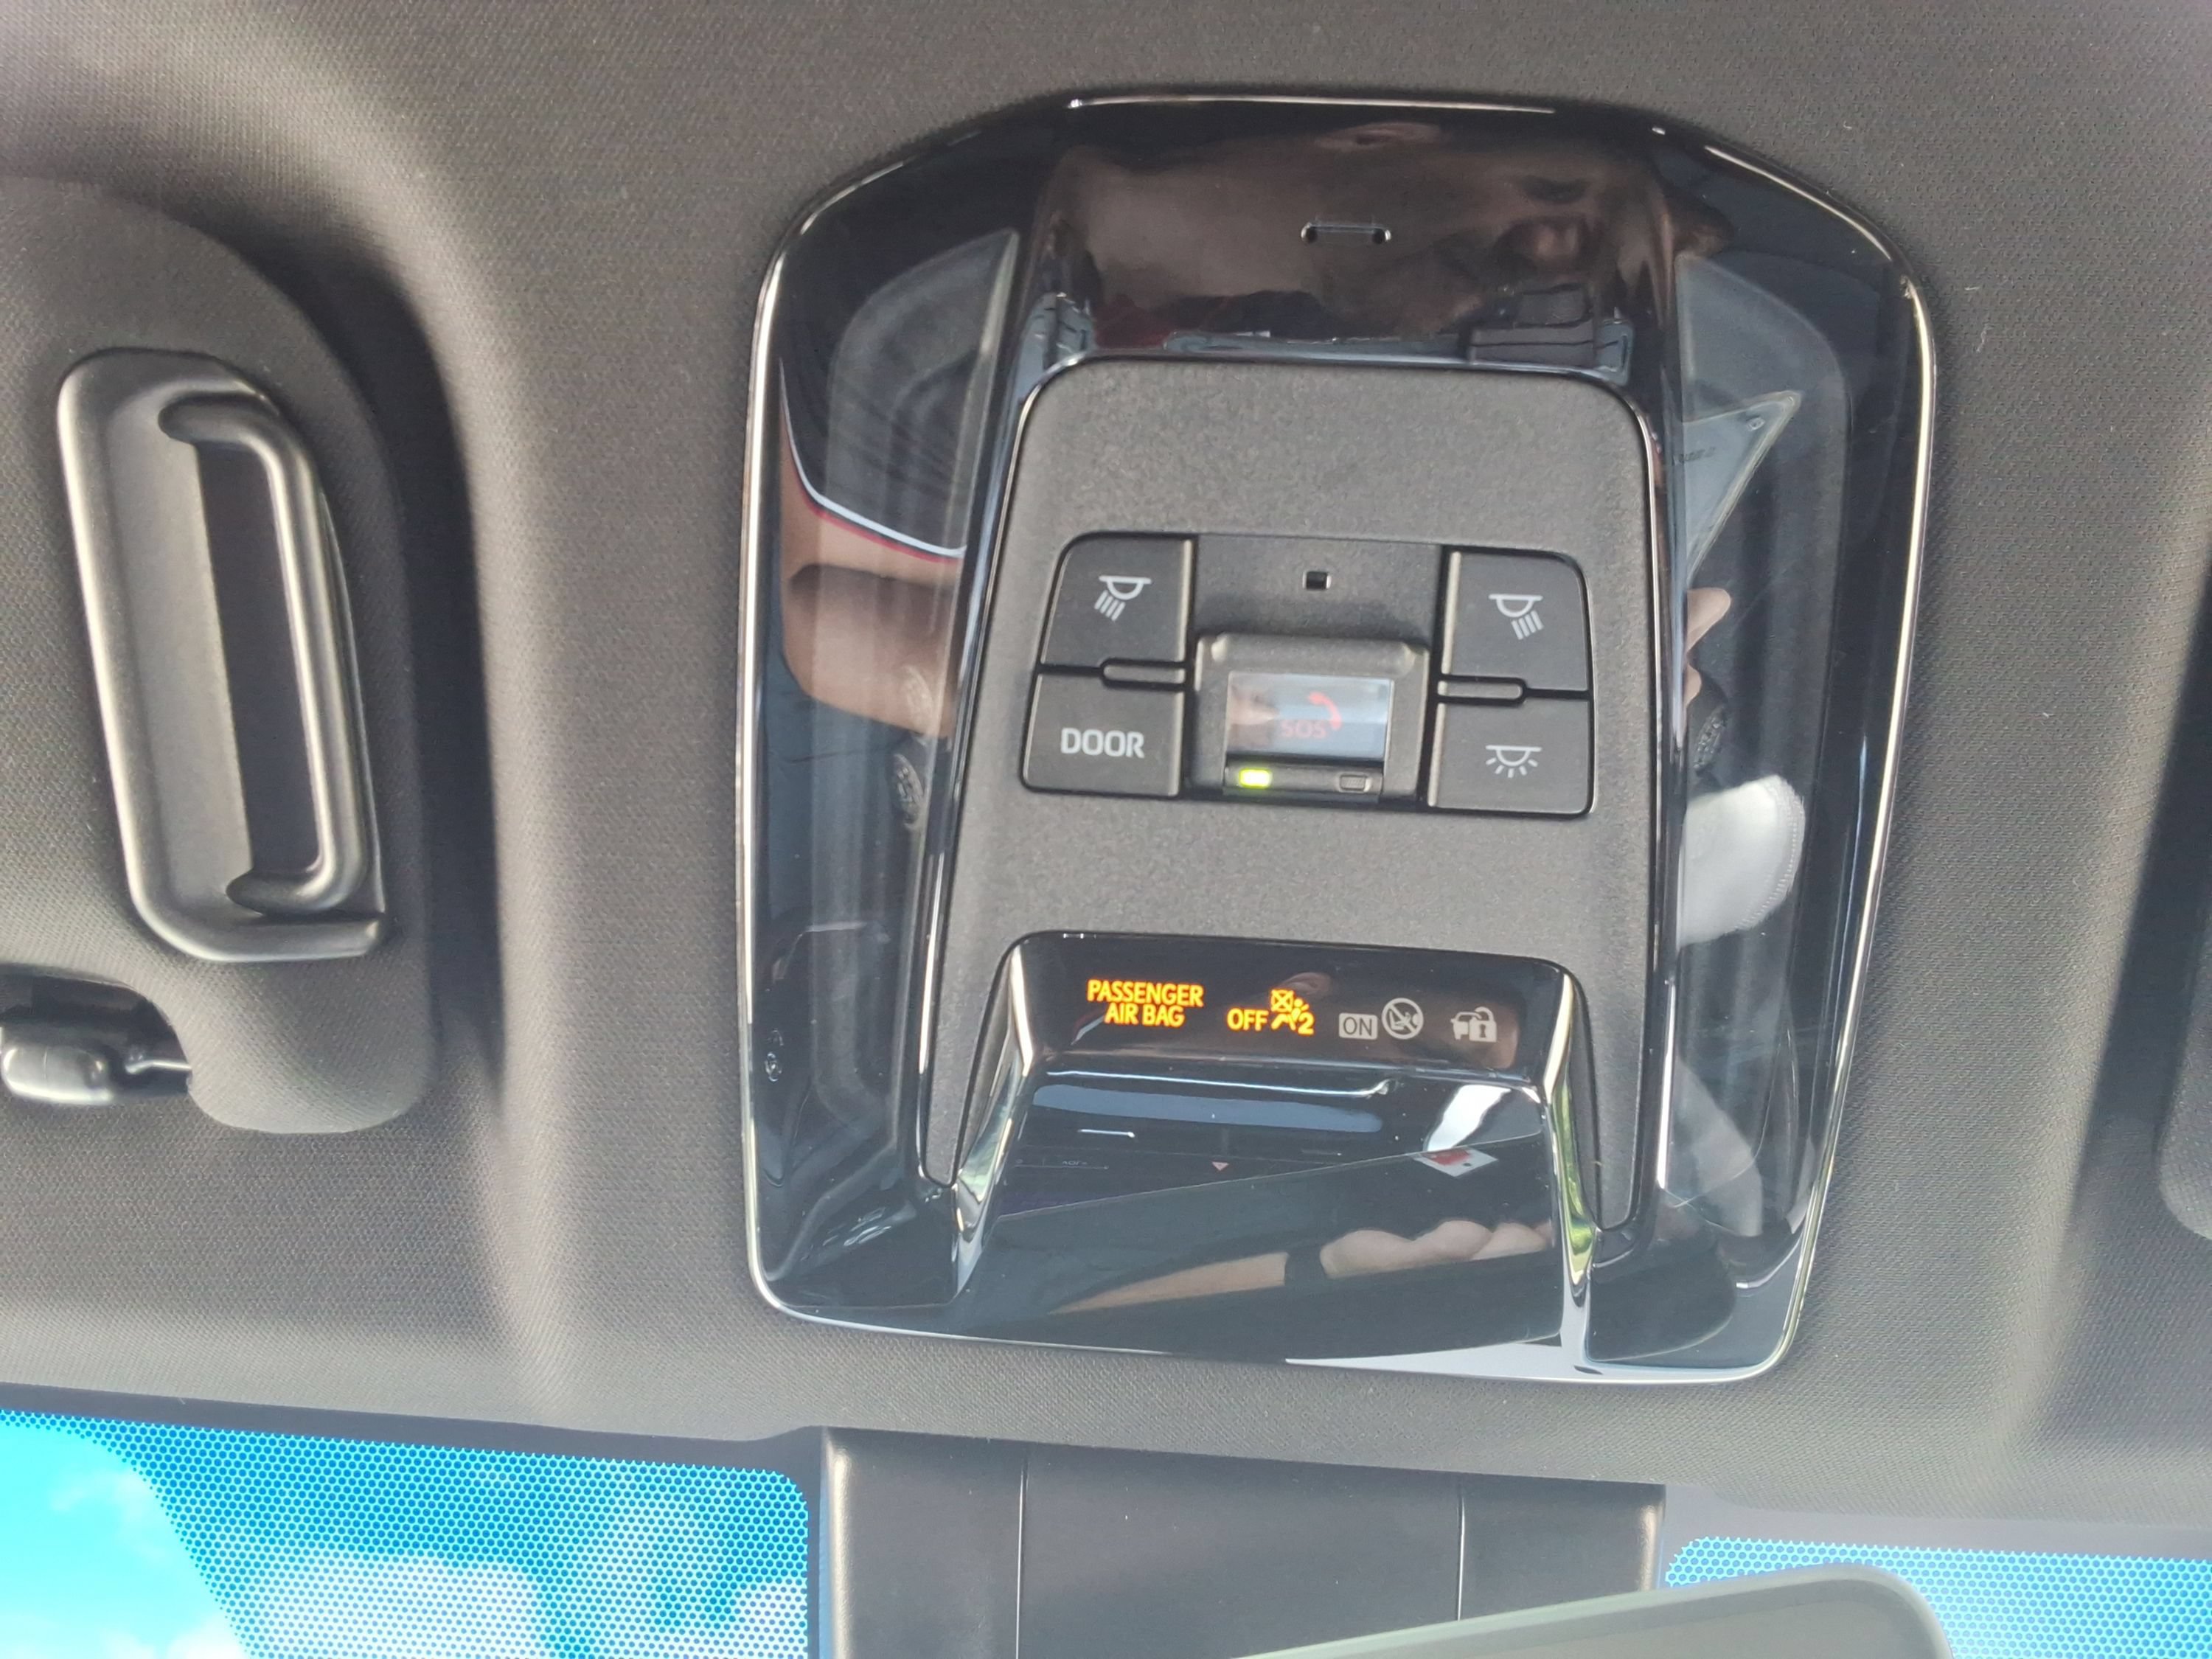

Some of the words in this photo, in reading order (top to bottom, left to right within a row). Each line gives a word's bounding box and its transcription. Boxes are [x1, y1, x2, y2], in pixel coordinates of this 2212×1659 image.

[1281, 718, 1326, 738] SOS
[1061, 727, 1144, 759] DOOR
[1087, 978, 1204, 1008] PASSENGER
[1104, 1002, 1139, 1026] AIR
[1141, 1004, 1186, 1027] BAG
[1227, 1007, 1269, 1032] OFF
[1297, 1012, 1315, 1035] 2
[1343, 1016, 1373, 1037] ON
